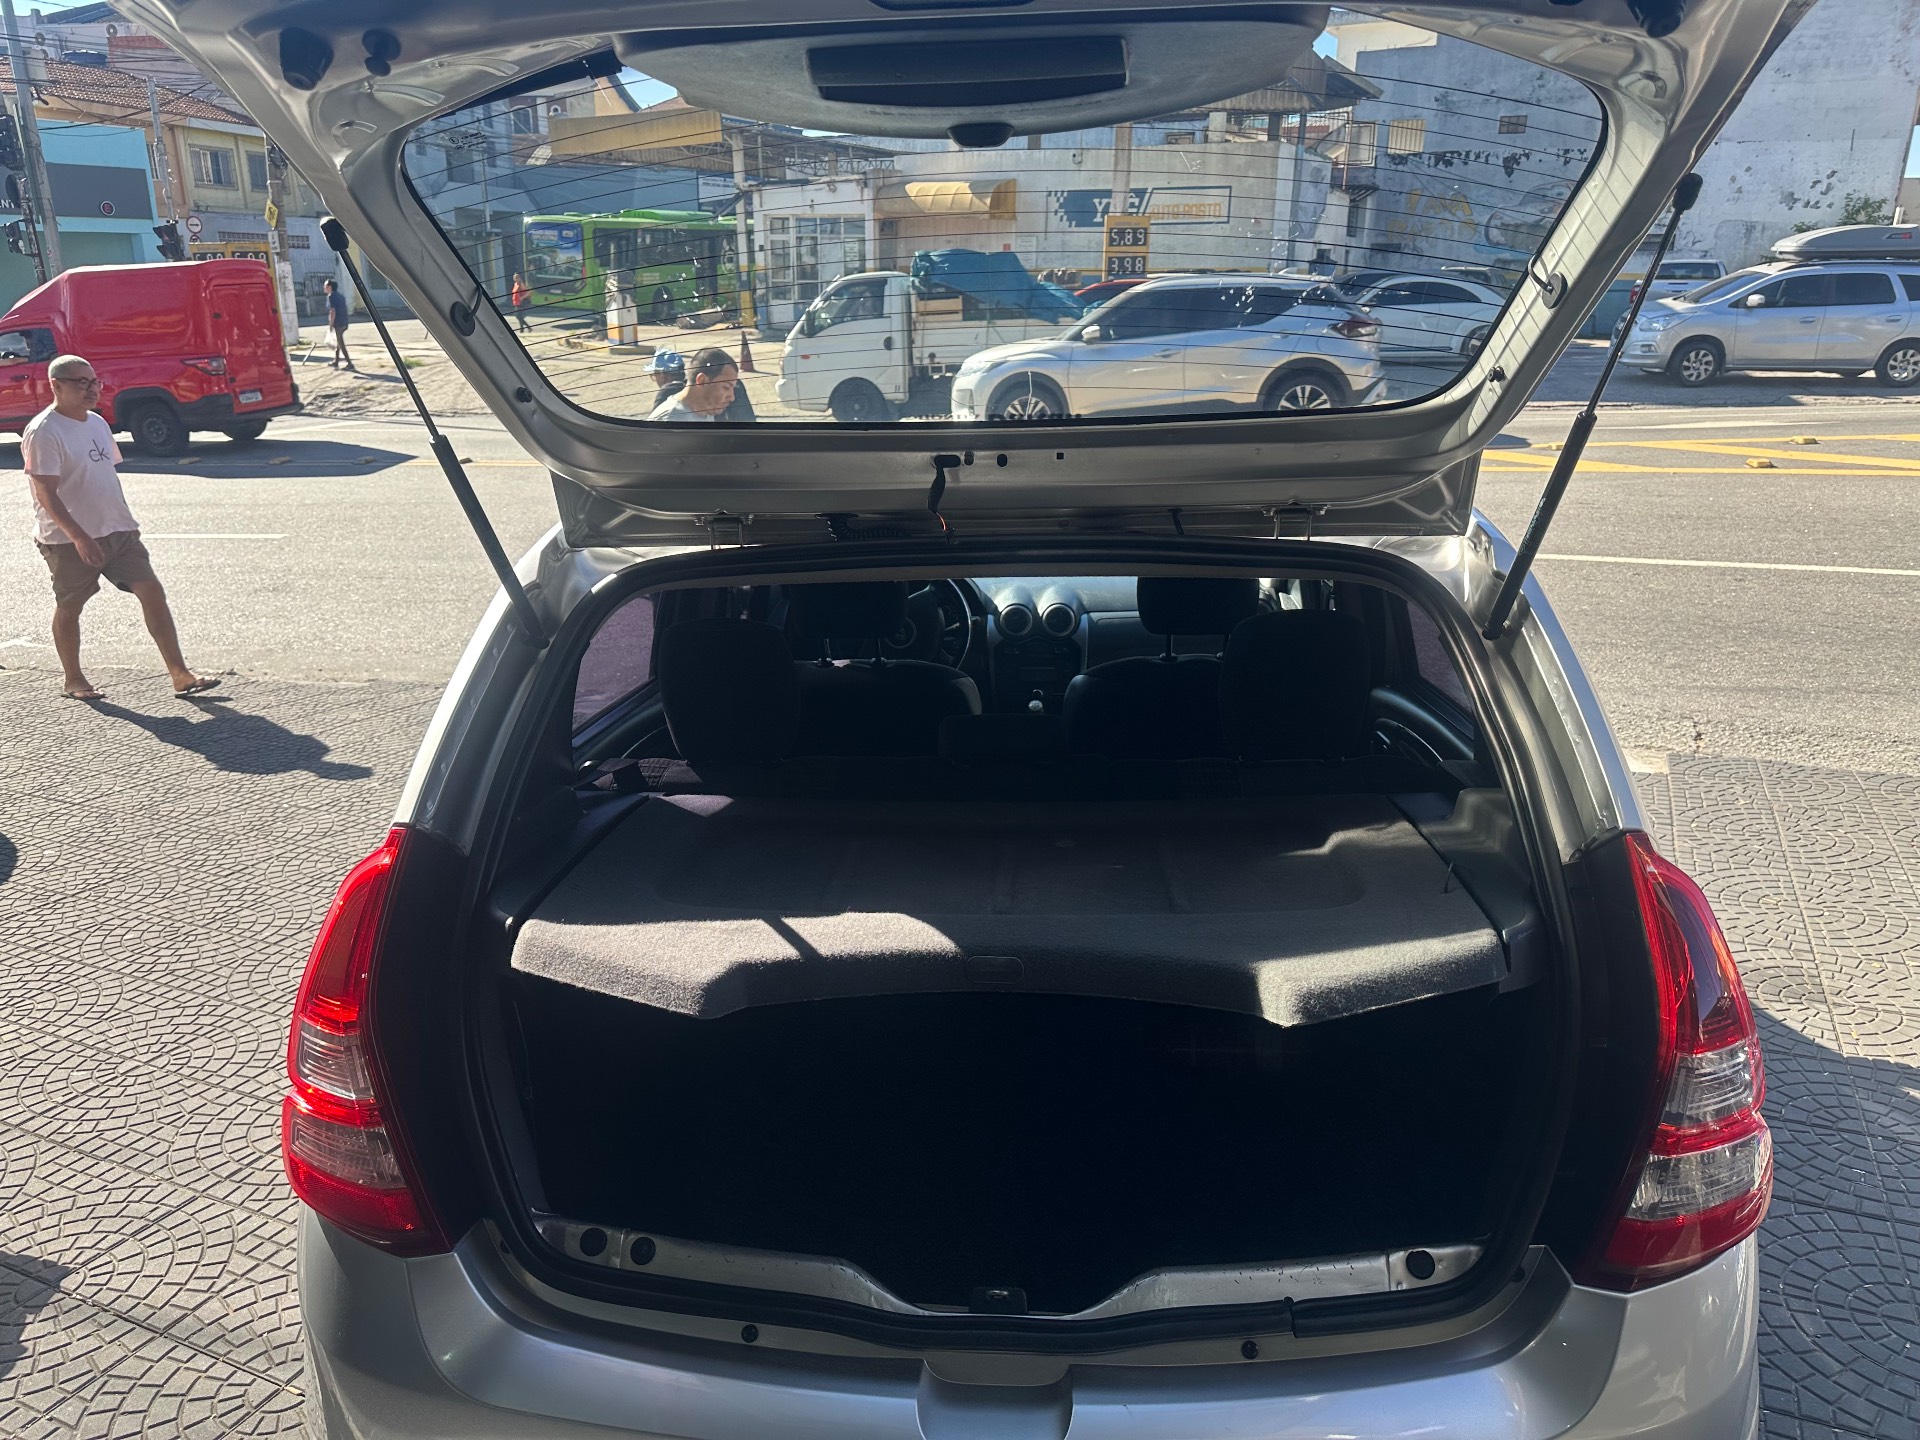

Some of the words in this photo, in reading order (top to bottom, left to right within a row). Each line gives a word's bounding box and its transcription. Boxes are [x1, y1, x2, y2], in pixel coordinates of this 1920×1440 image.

[1092, 192, 1140, 222] YÊ
[1111, 228, 1146, 247] 5,89
[1110, 257, 1145, 275] 3,98
